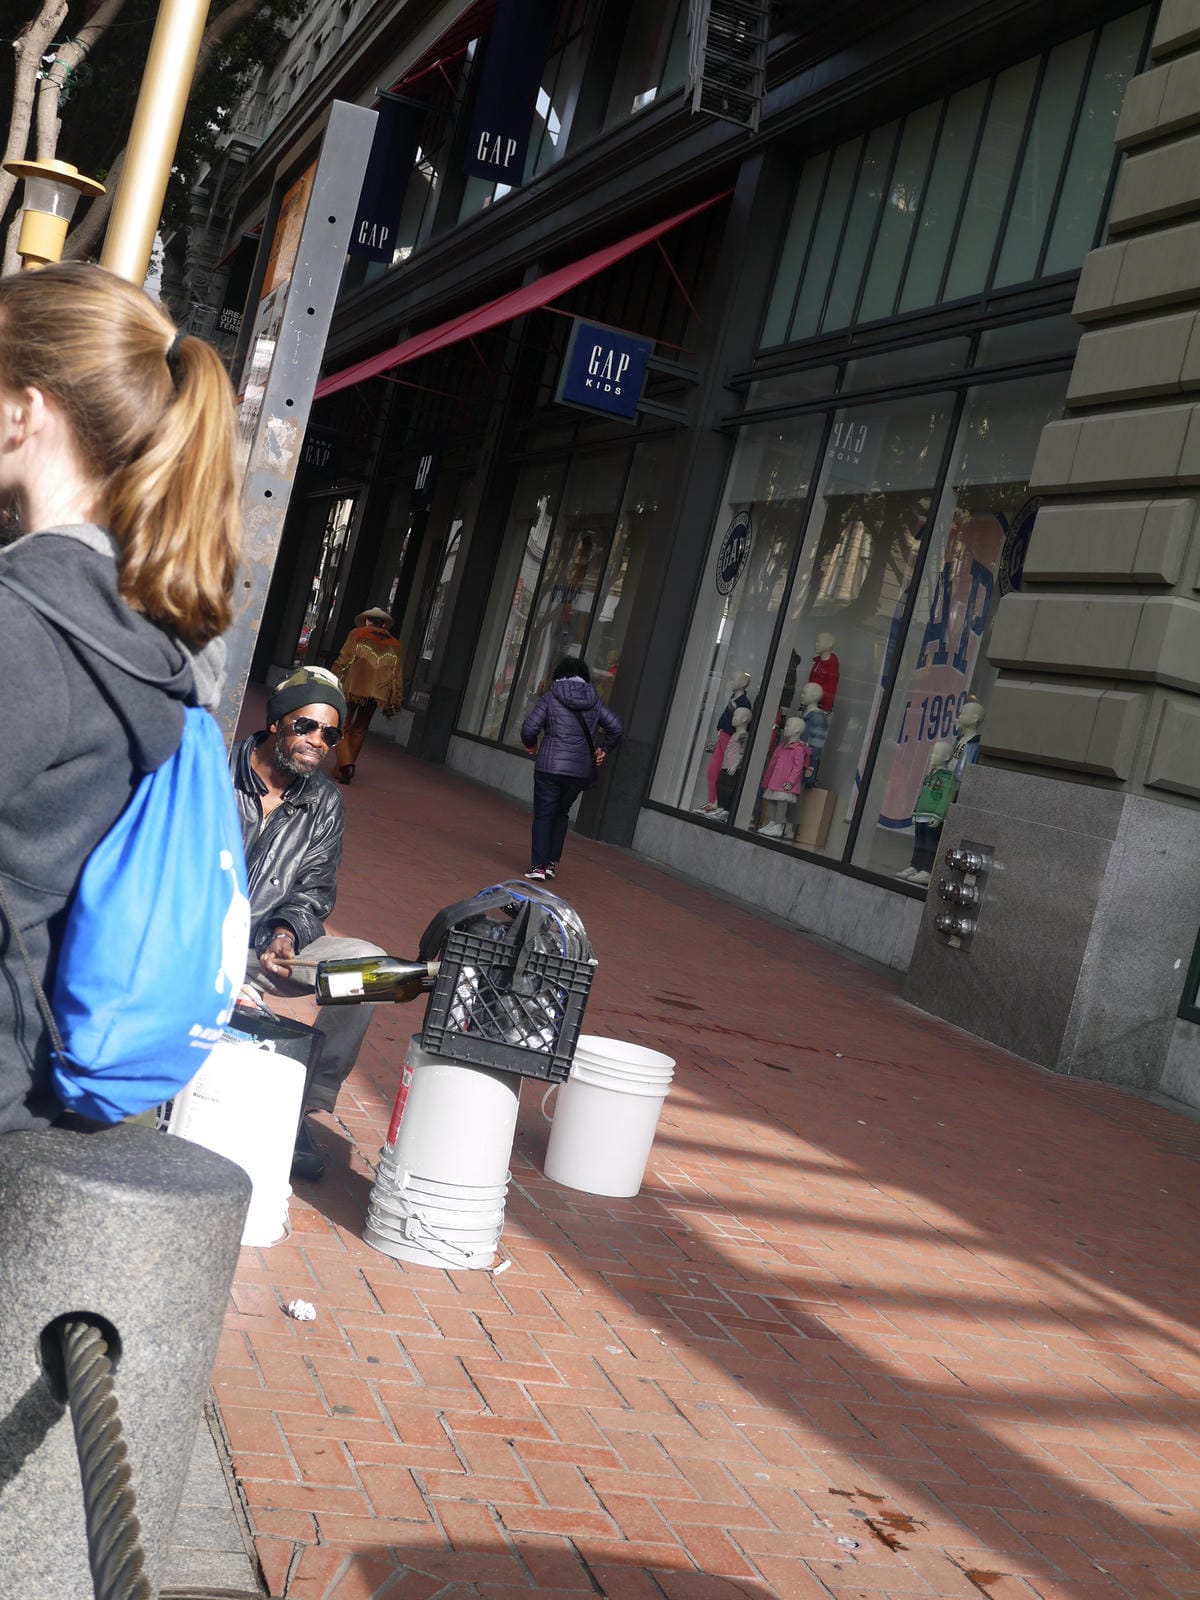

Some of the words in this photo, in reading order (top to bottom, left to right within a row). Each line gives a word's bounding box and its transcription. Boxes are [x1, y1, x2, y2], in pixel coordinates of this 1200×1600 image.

[477, 131, 517, 168] GAP
[358, 220, 389, 249] GAP
[222, 308, 242, 320] URB
[588, 345, 630, 383] GAP
[585, 378, 622, 396] KIDS
[305, 444, 331, 468] GAP
